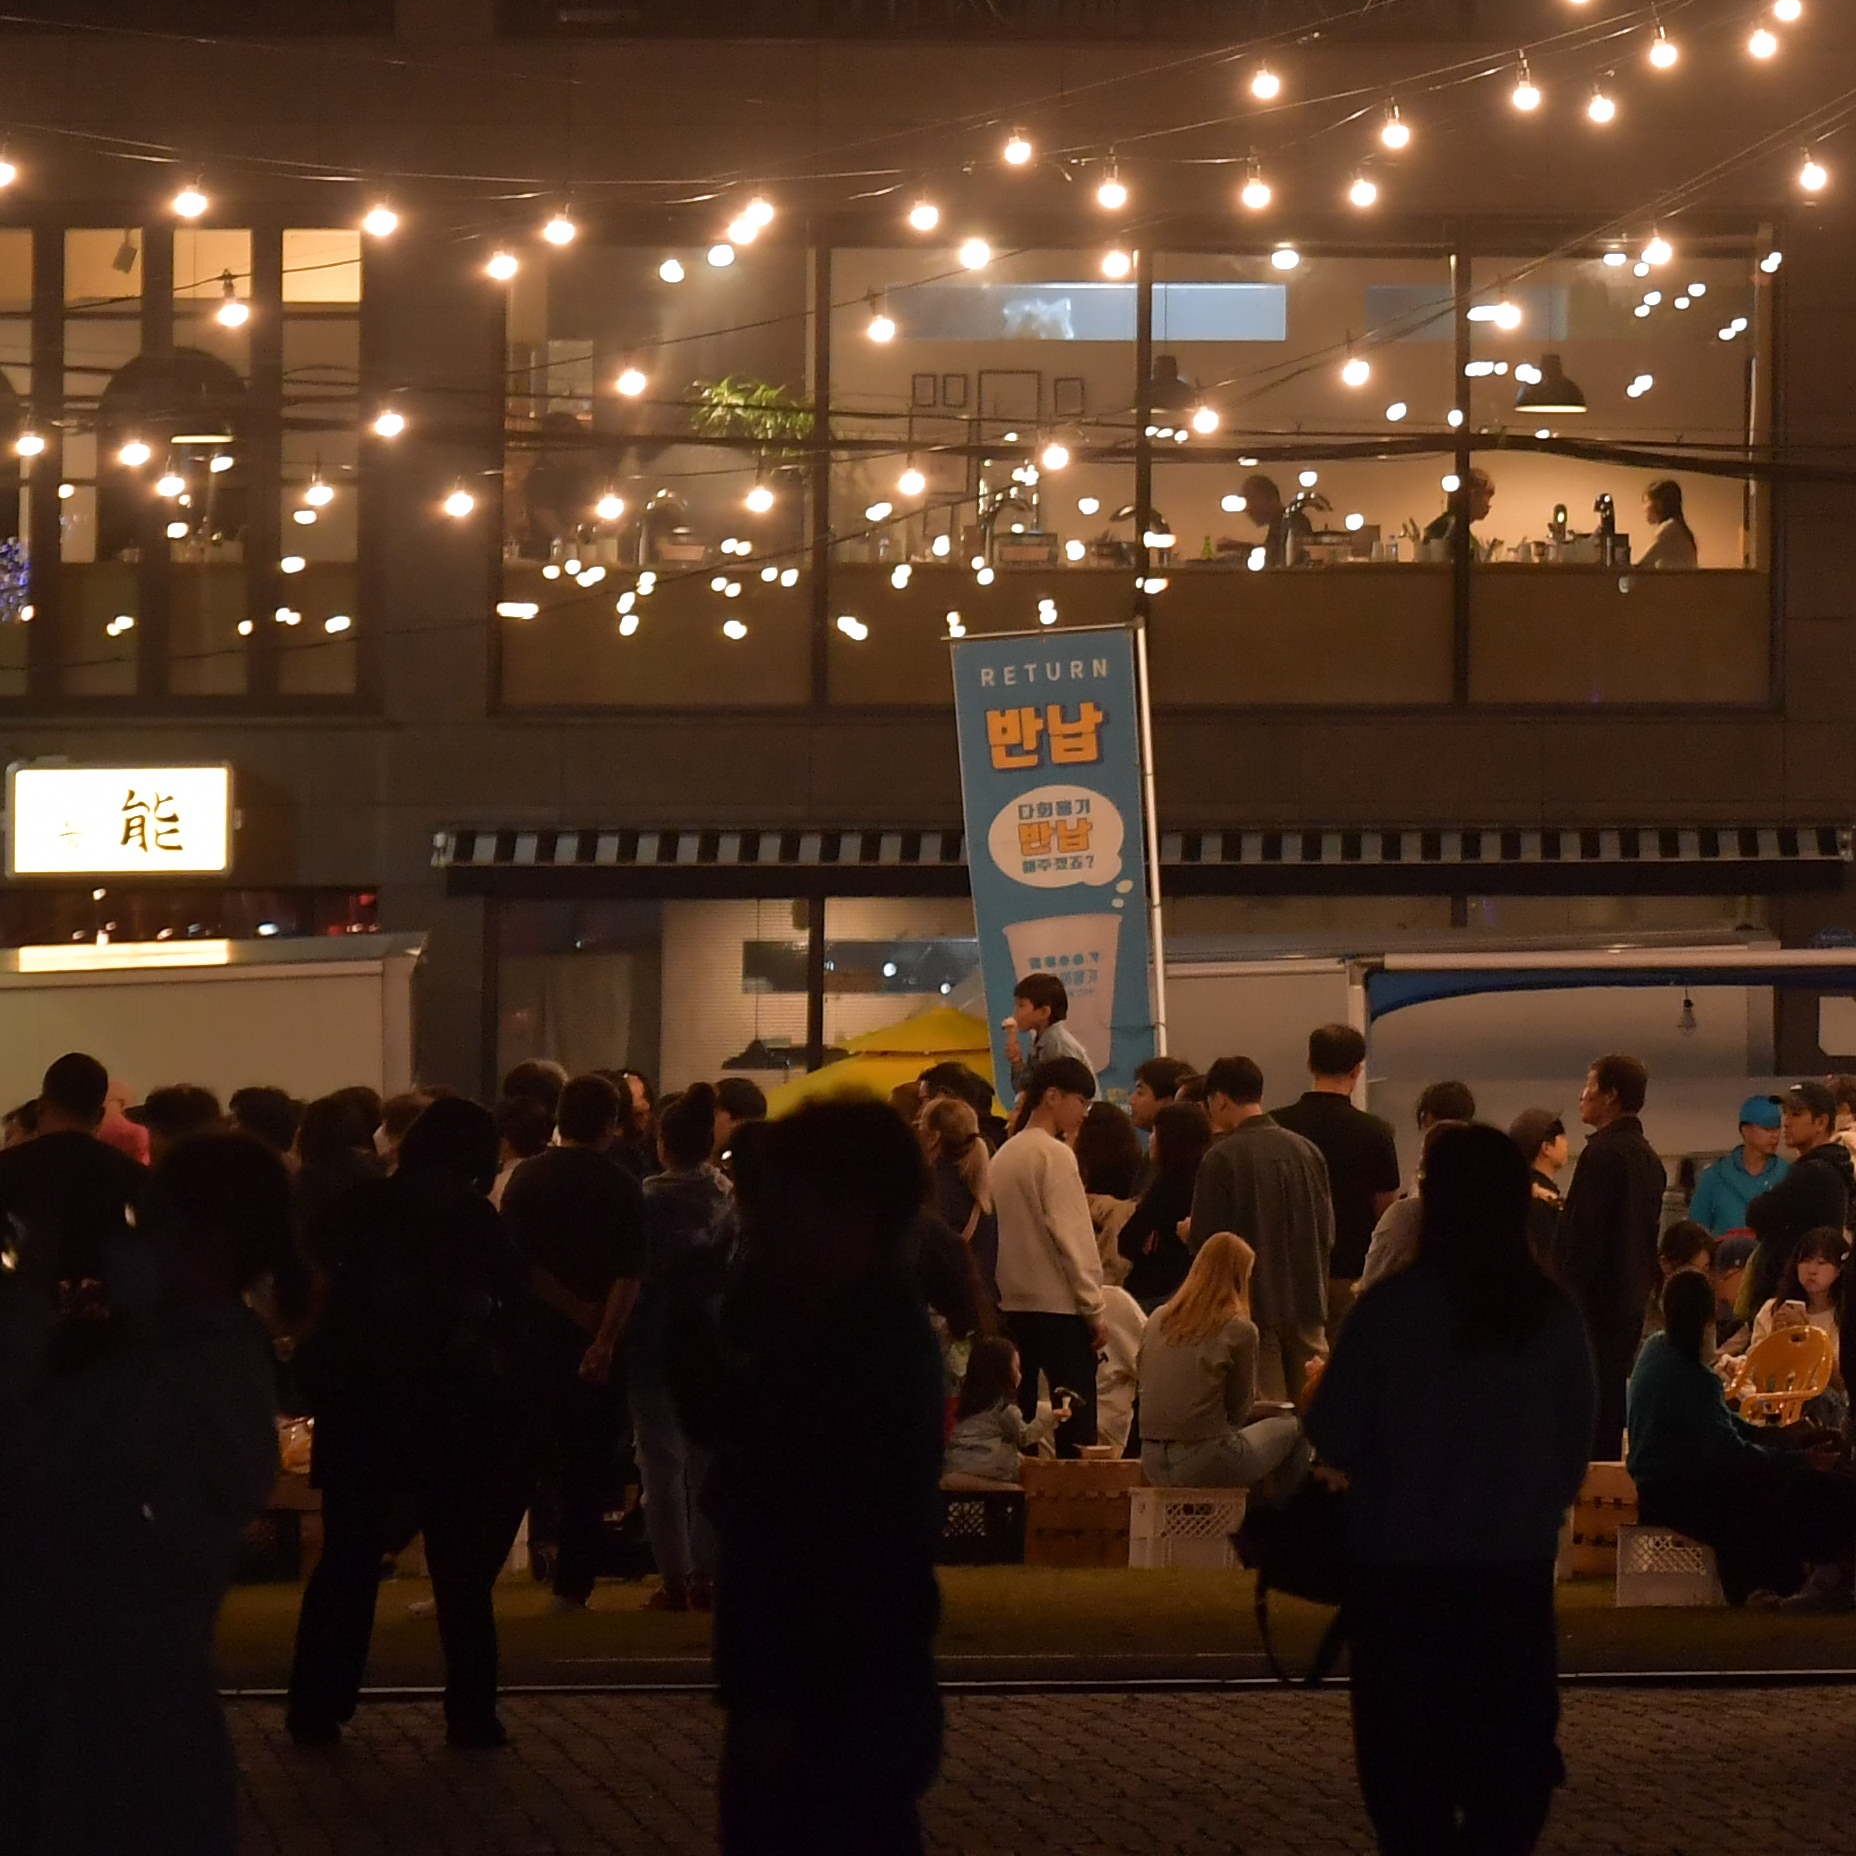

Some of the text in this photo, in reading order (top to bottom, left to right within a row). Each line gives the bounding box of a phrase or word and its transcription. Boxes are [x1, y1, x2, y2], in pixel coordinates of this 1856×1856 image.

[980, 658, 1107, 687] RETURN
[985, 701, 1105, 771] 반납
[119, 788, 184, 853] 能
[1018, 798, 1091, 821] 다회용기
[1018, 817, 1093, 857] 반납
